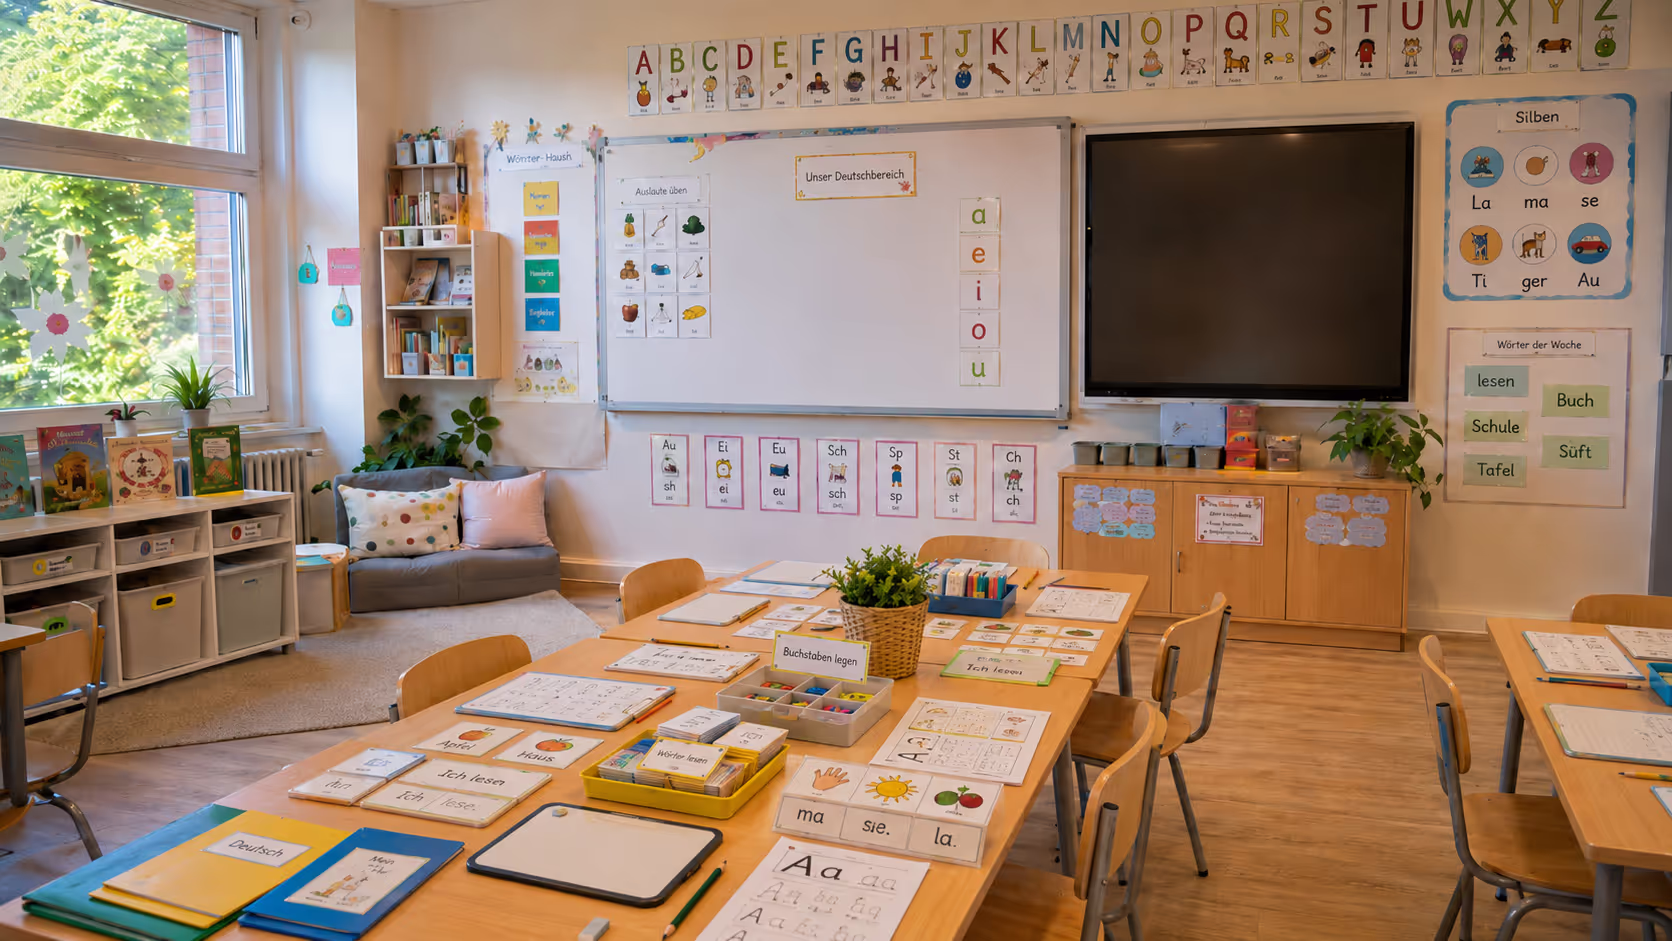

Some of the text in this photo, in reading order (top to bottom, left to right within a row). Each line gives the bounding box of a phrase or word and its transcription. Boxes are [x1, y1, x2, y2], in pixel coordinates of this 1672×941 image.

[635, 50, 653, 76] A
[670, 47, 685, 74] B
[702, 45, 719, 72] C
[737, 43, 754, 71] D
[773, 40, 788, 69] E
[811, 38, 826, 66] F
[844, 36, 864, 64] G
[881, 34, 899, 63] H
[919, 31, 934, 61] I
[954, 29, 972, 58] J
[992, 27, 1009, 56] K
[1030, 25, 1047, 53] L
[1063, 22, 1084, 52] M
[1100, 19, 1120, 49] N
[1140, 16, 1163, 46] O
[1185, 13, 1204, 44] P
[1224, 10, 1249, 42] Q
[1271, 8, 1291, 39] R
[1313, 5, 1333, 35] S
[1356, 3, 1378, 33] T
[1401, 0, 1424, 31] U
[1445, 0, 1474, 29] W
[1495, 0, 1518, 27] X
[1547, 0, 1565, 25] Y
[1515, 110, 1560, 124] Silben
[805, 168, 906, 184] Unser Deutschbereich
[635, 185, 688, 196] Auslaute üben
[1472, 194, 1599, 210] La ma se
[971, 208, 987, 225] a
[971, 247, 986, 264] e
[1471, 272, 1600, 293] Ti ger Au
[976, 279, 982, 301] i
[971, 323, 987, 340] o
[1497, 339, 1582, 350] Wörter der Woche
[971, 361, 987, 378] u
[1477, 373, 1515, 388] lesen
[1557, 392, 1594, 408] Buch
[1471, 418, 1520, 434] Schule
[662, 439, 676, 451] Au
[718, 440, 729, 453] Ei
[772, 442, 786, 455] Eu
[827, 444, 847, 457] Sch
[1559, 444, 1592, 459] Süft
[889, 446, 903, 462] Sp
[948, 448, 960, 461] St
[1005, 450, 1022, 463] Ch
[1476, 462, 1515, 477] Tafel
[663, 480, 676, 492] sh
[718, 485, 729, 494] ei
[772, 487, 786, 497] eu
[828, 487, 847, 499] sch
[889, 492, 903, 505] sp
[948, 492, 960, 503] st
[1006, 494, 1020, 506] ch
[782, 646, 858, 669] Buchstaben legen
[515, 750, 555, 763] Haus
[437, 769, 467, 780] Ich
[395, 790, 424, 802] Ich
[796, 808, 957, 848] ma sie. la.
[228, 839, 284, 858] Deutsch
